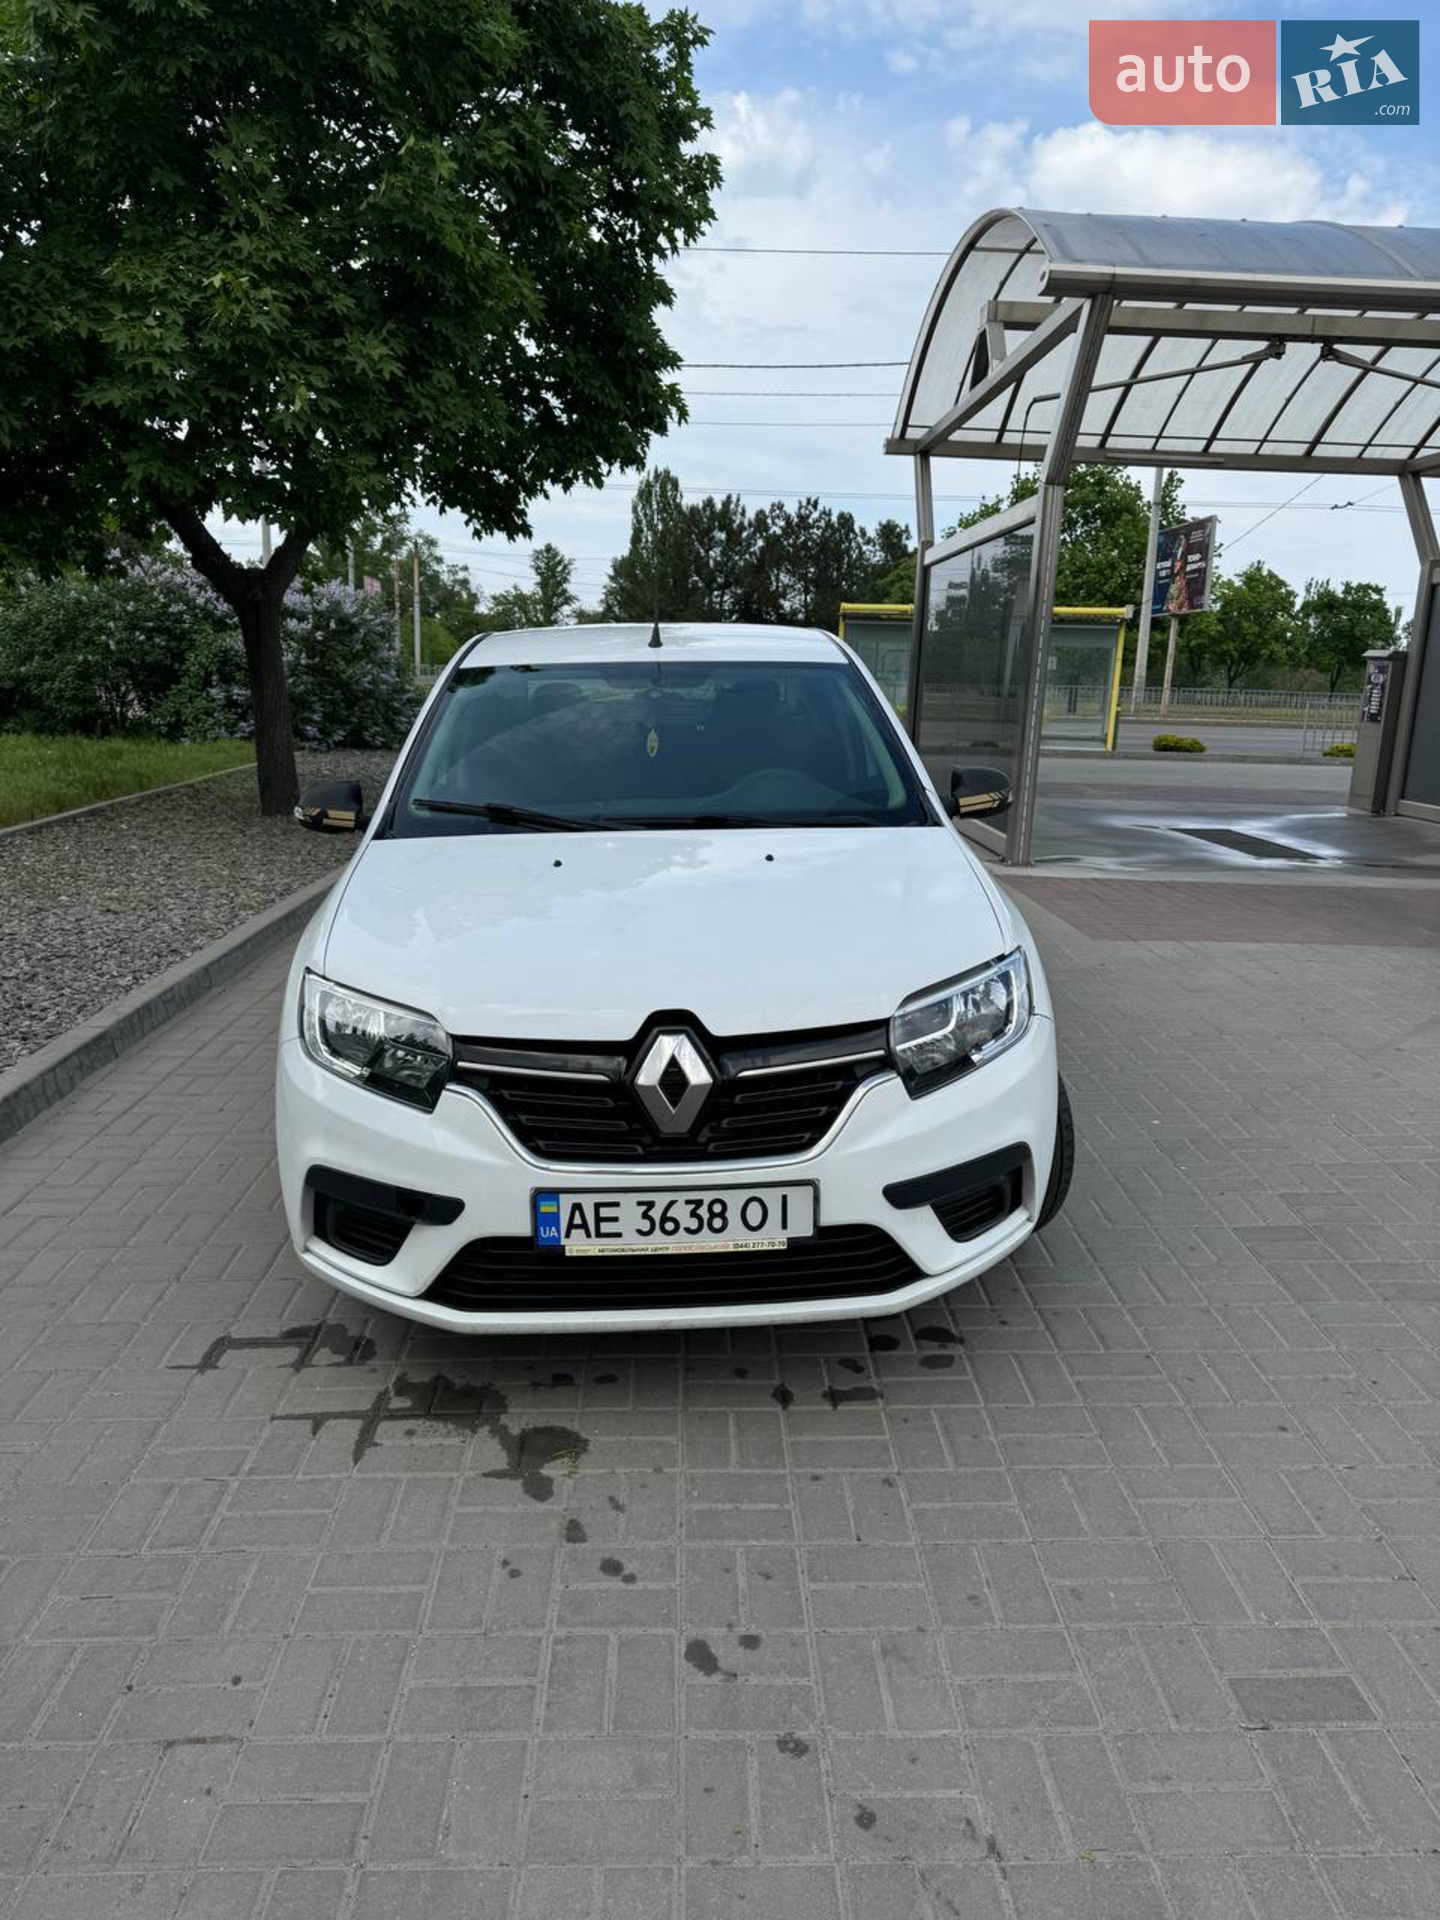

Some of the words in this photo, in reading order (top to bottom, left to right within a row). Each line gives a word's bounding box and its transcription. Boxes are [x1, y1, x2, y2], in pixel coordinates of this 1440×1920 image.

[564, 1201, 623, 1239] AE
[635, 1198, 729, 1236] 3638
[539, 1226, 559, 1238] UA
[732, 1241, 750, 1250] (044)
[752, 1239, 787, 1249] 277-70-70
